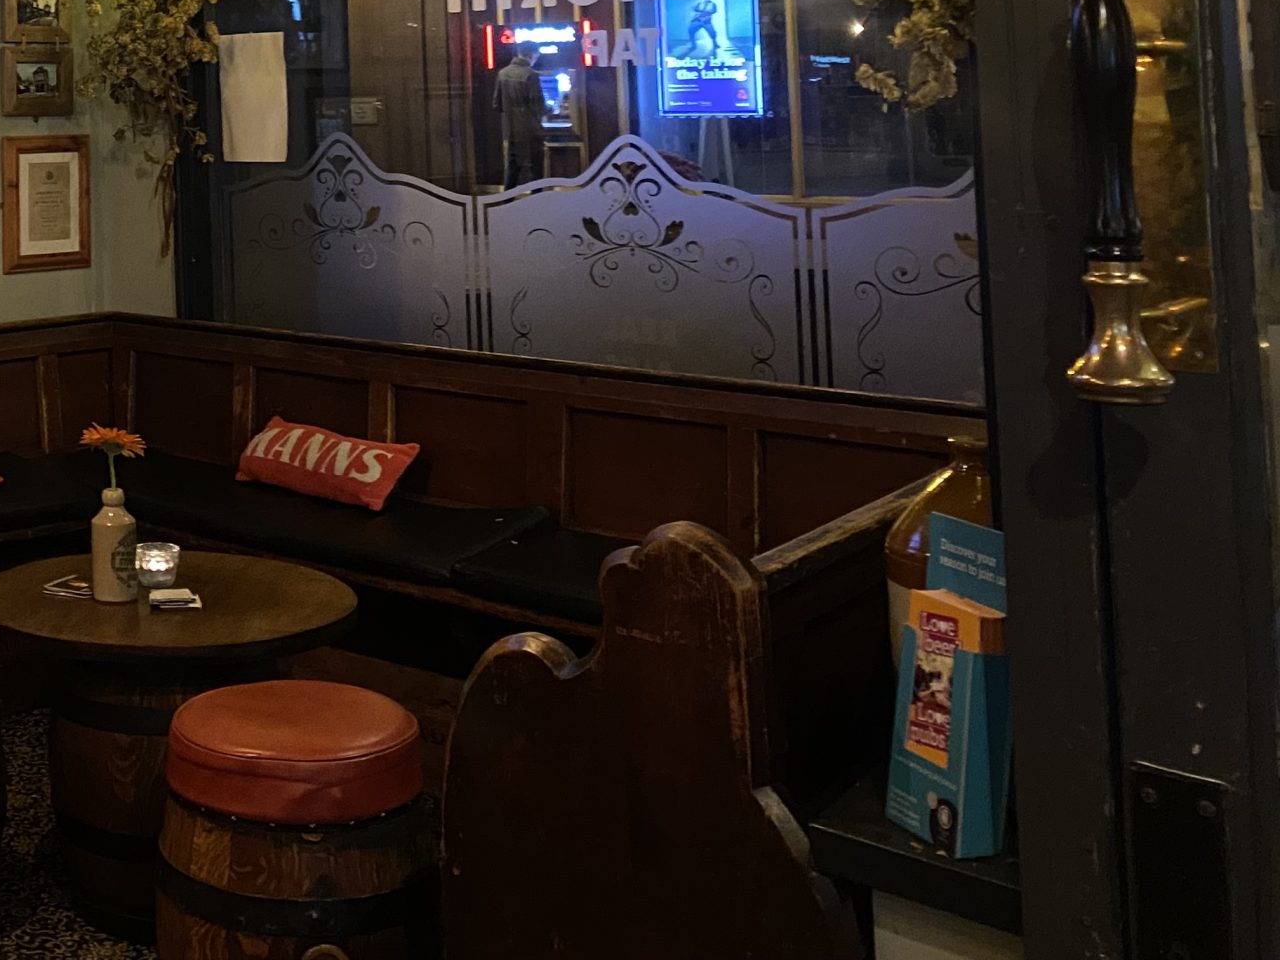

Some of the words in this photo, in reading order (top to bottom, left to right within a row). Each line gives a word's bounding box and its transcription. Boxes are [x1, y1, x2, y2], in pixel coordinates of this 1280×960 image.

[665, 56, 707, 70] Today
[676, 69, 698, 80] the
[701, 68, 747, 81] taking
[940, 538, 976, 559] Discover
[976, 552, 997, 567] your
[939, 556, 967, 571] reason
[968, 563, 978, 575] to
[977, 568, 995, 583] join
[921, 612, 956, 637] Love
